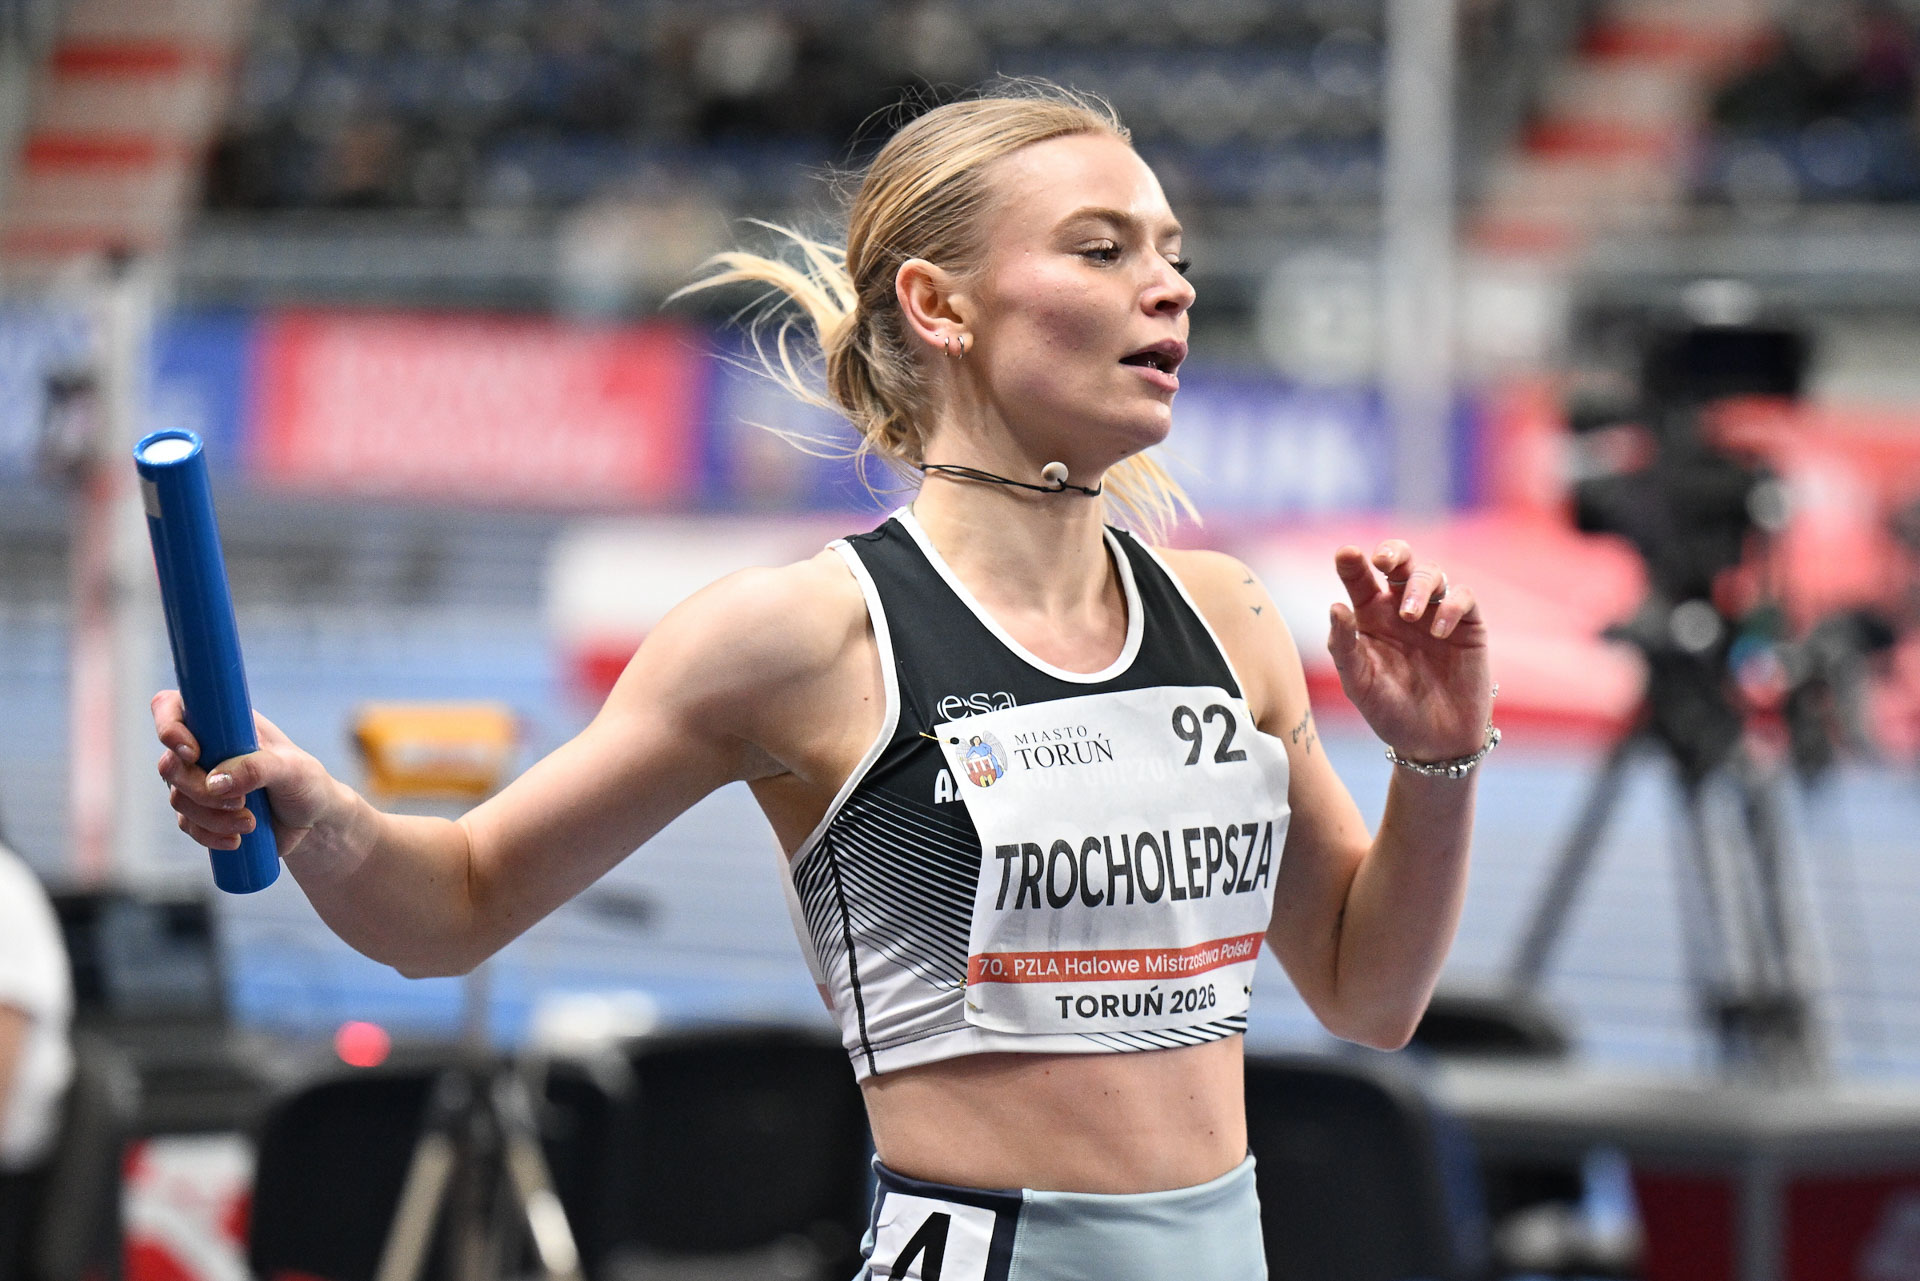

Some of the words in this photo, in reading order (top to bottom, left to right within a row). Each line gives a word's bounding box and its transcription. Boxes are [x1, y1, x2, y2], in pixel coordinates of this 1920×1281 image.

[1014, 733, 1114, 770] TORUŃ
[1015, 725, 1088, 745] MIASTO
[1172, 704, 1247, 766] 92
[995, 821, 1273, 911] TROCHOLEPSZA
[979, 959, 1008, 976] 70.
[1014, 958, 1059, 976] PZLA
[1065, 955, 1140, 975] Halowe
[1146, 948, 1218, 973] Mistrzostwa
[1220, 938, 1254, 961] Polski
[1055, 985, 1164, 1019] TORUŃ
[1169, 983, 1216, 1014] 2026
